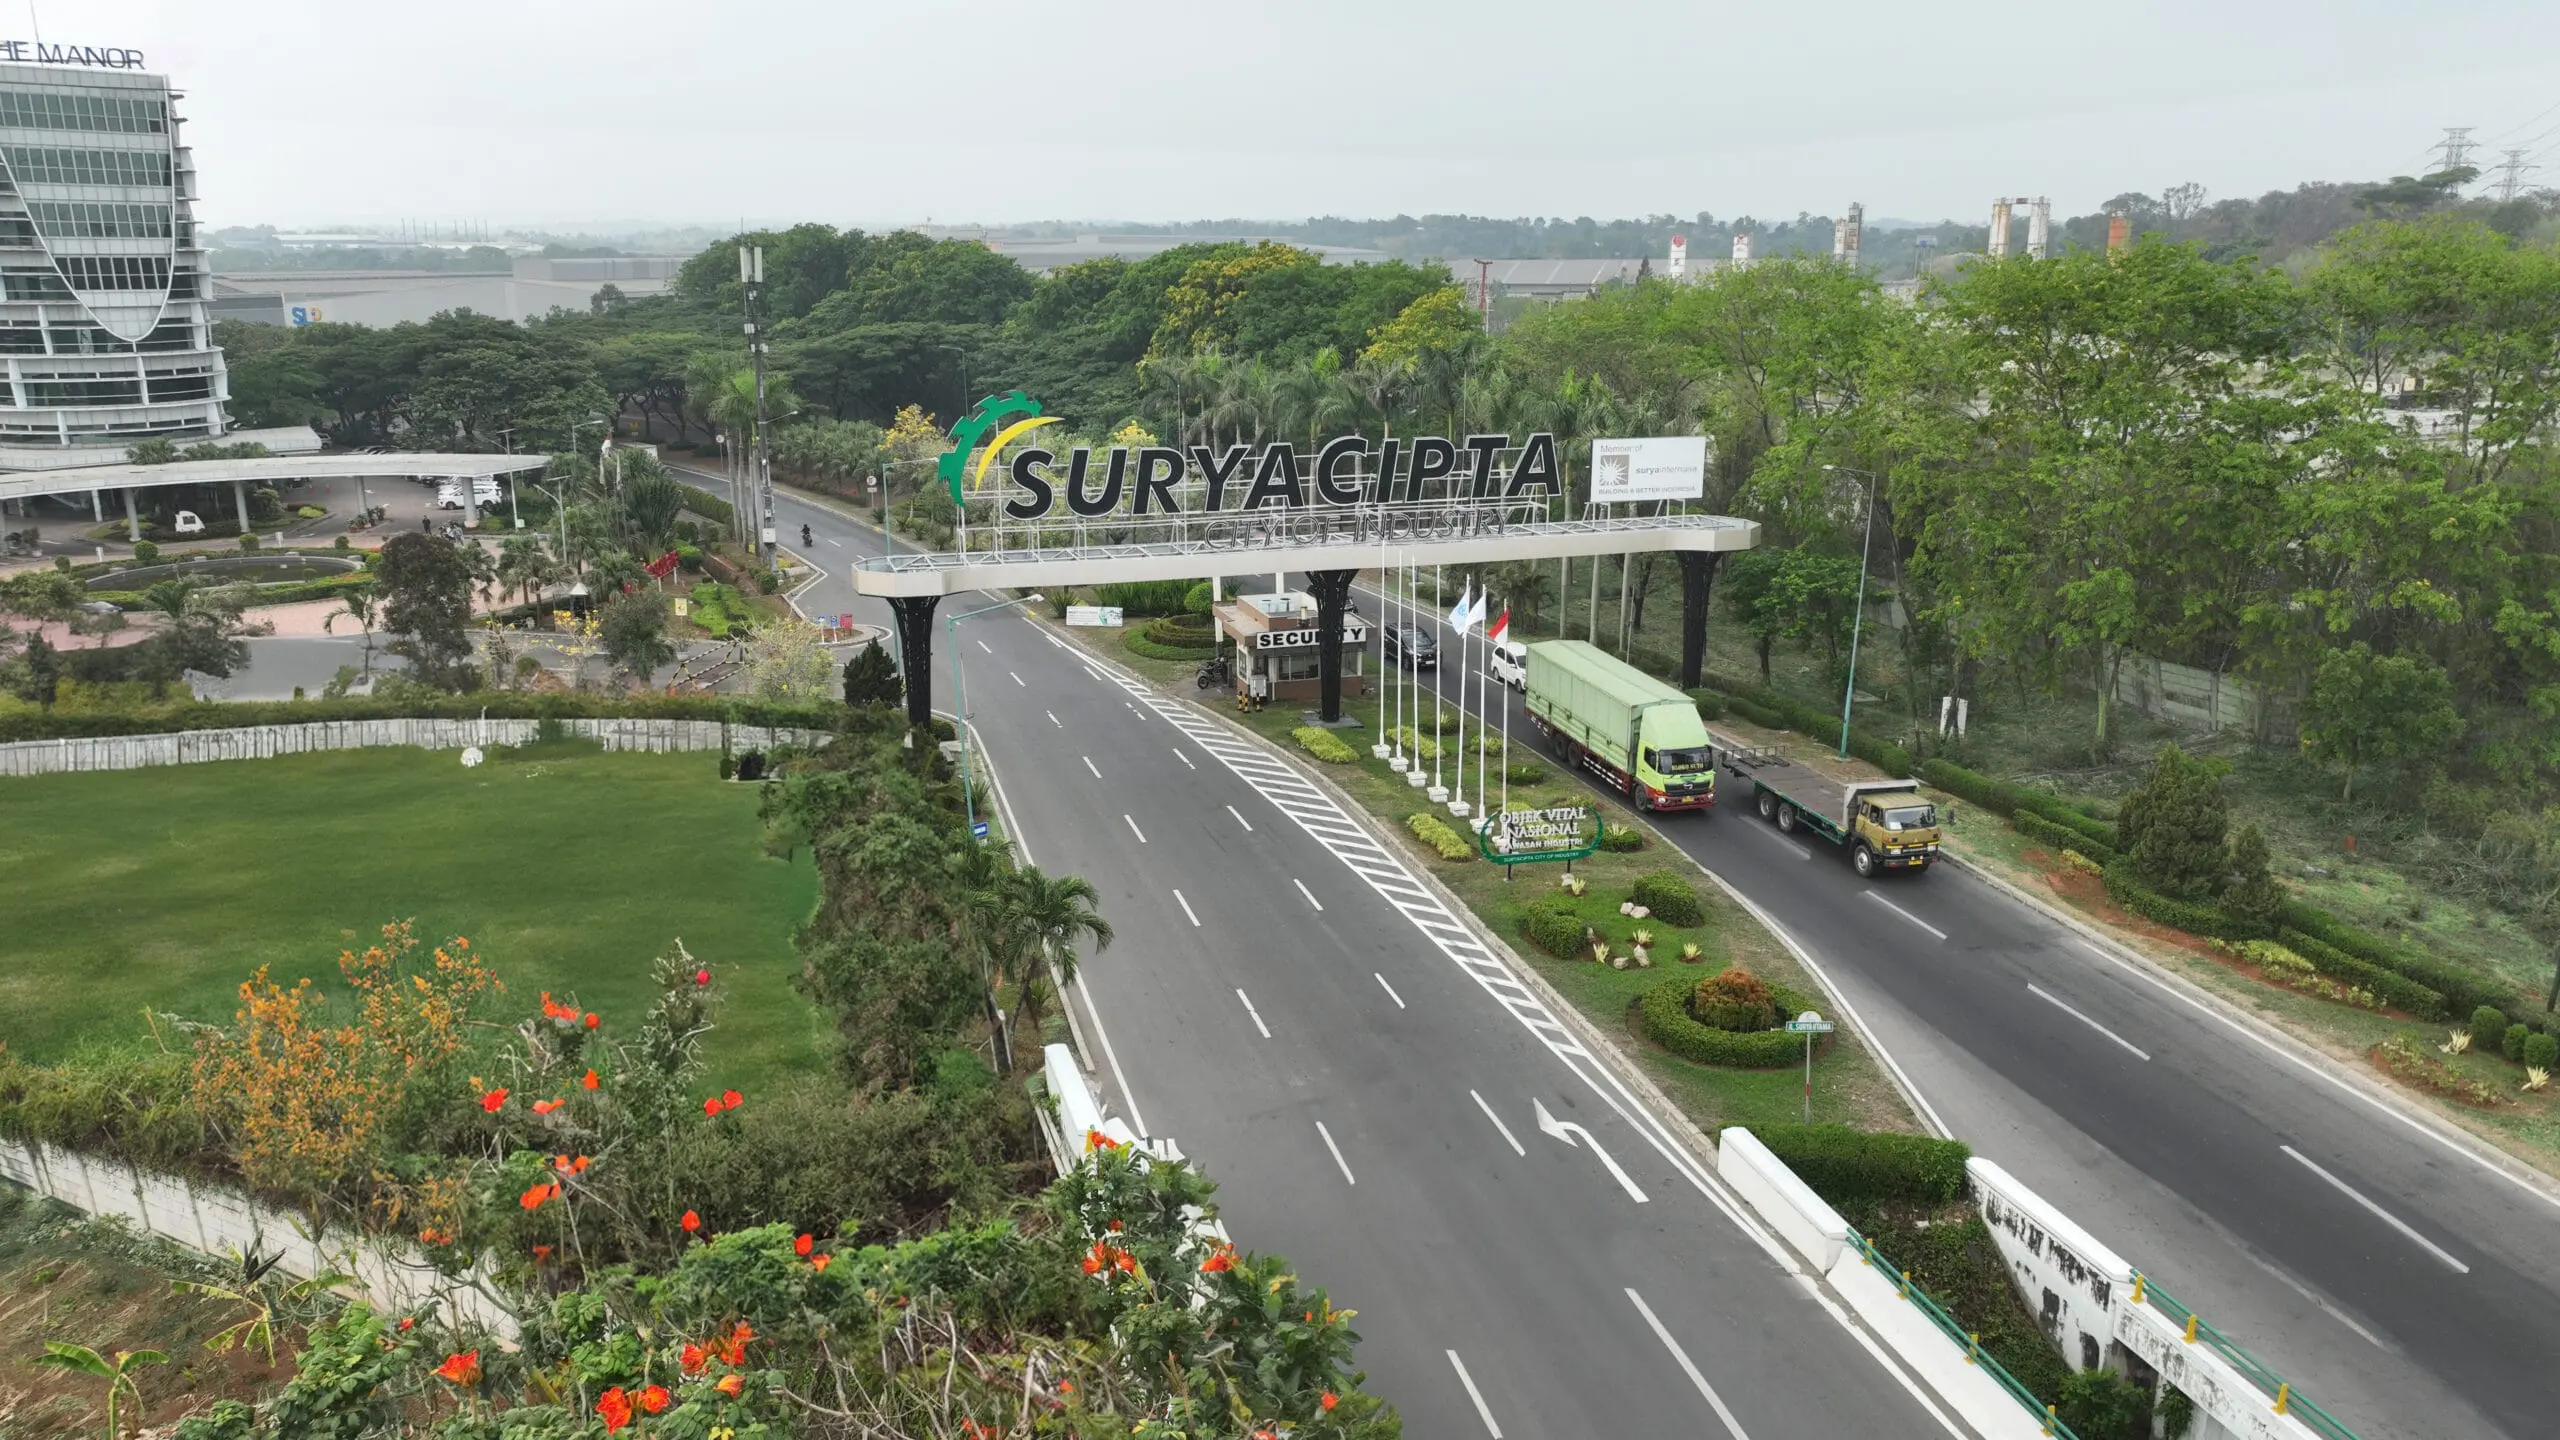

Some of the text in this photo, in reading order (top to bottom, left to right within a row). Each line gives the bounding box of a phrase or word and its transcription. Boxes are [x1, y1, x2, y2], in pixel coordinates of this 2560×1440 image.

[38, 43, 145, 70] MANOR
[1003, 432, 1562, 520] SURYACIPTA
[1205, 507, 1514, 549] CITY OF INDUSTRY
[1259, 627, 1363, 647] SECUY
[1499, 806, 1587, 826] OBJEK VITAL
[1506, 822, 1581, 839] NASIONAL
[1500, 838, 1542, 851] AWASAN
